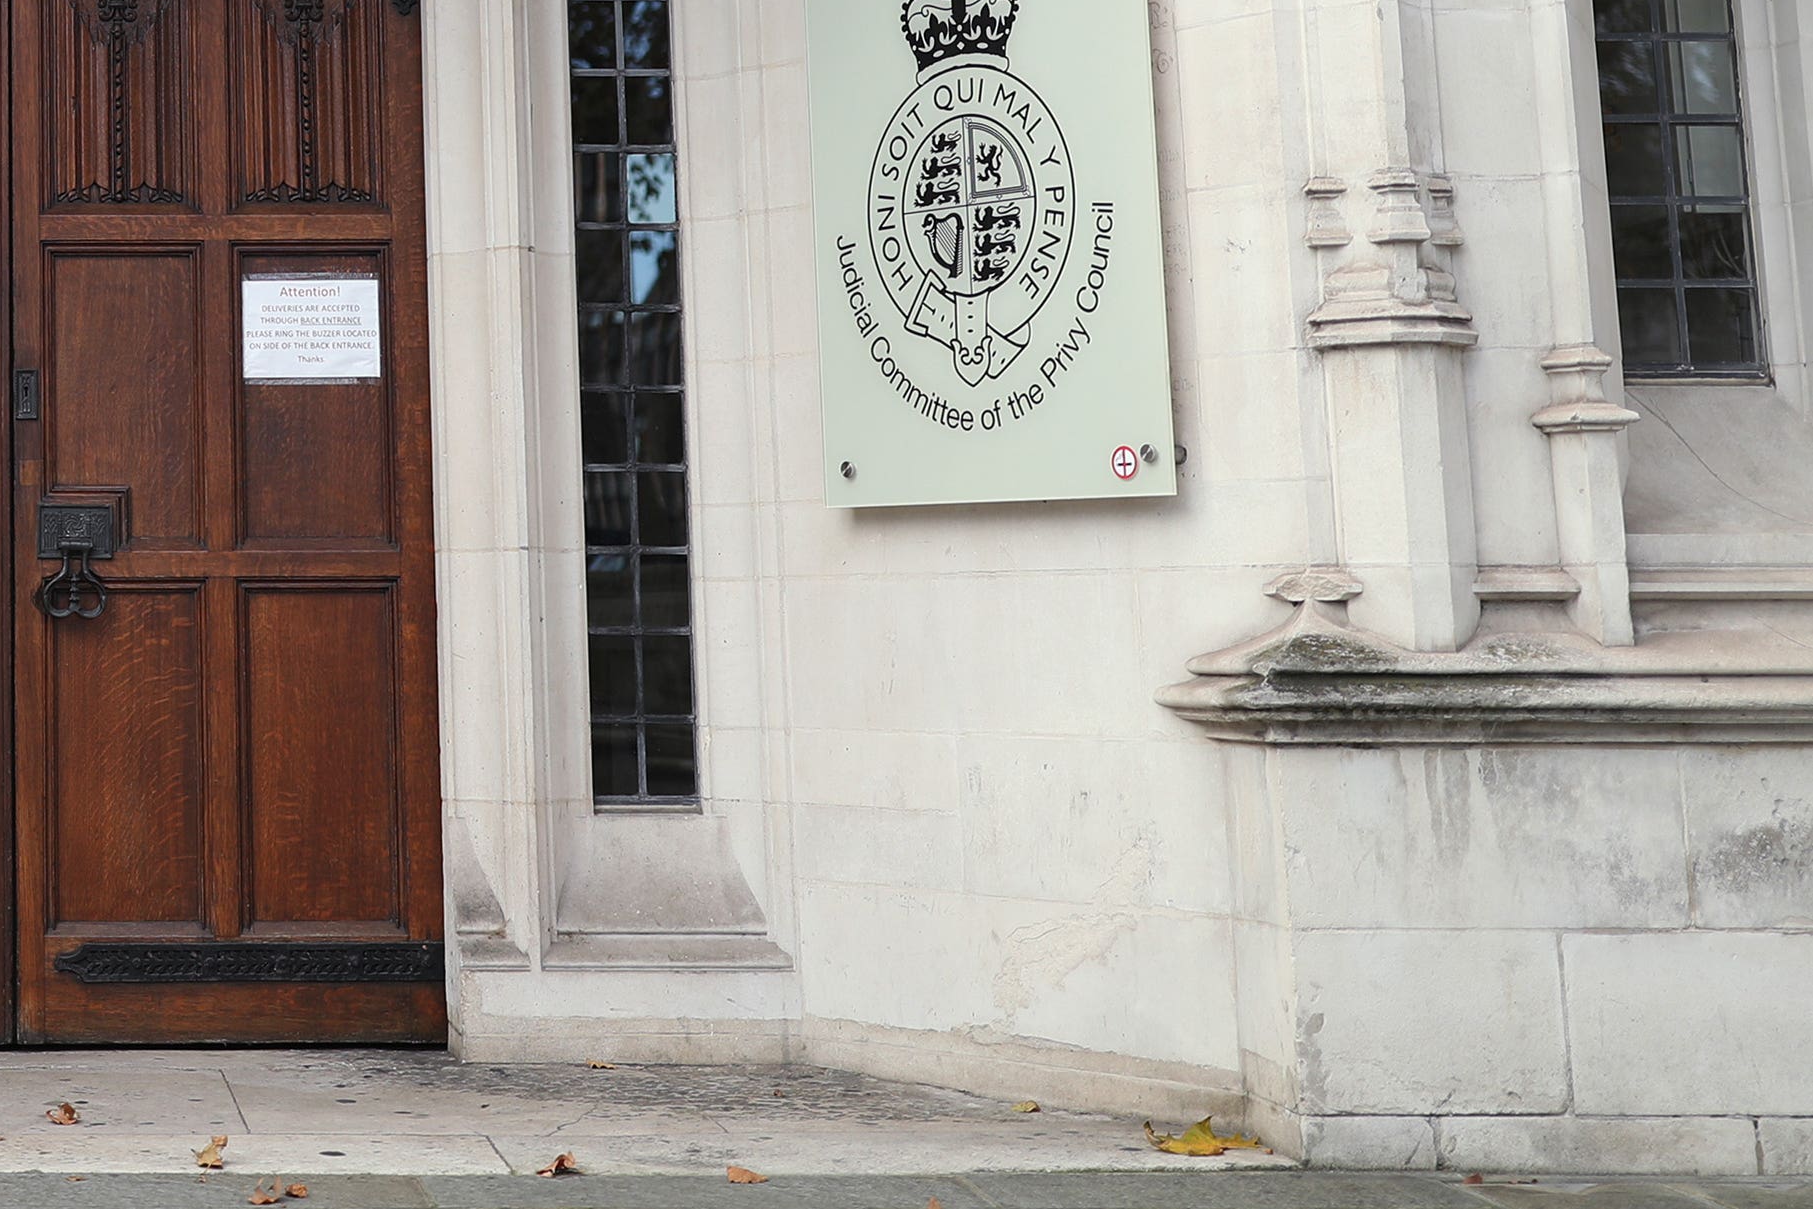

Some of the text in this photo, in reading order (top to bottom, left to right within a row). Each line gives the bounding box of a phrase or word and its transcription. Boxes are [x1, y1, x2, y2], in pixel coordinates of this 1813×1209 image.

[876, 77, 1065, 300] HONI SOIT QUI MAL Y PENSE
[279, 286, 341, 298] Attention!
[261, 304, 360, 313] DELIVERIES ARE ACCEPTED
[260, 317, 362, 325] THROUGH BACK ENTRANCE
[836, 202, 1114, 432] Judicial Committee of the Privy Council
[246, 330, 377, 338] PLEASE RING THE BUZZER LOCATED
[249, 342, 261, 350] ON
[262, 342, 279, 350] SIDE
[281, 342, 291, 350] OF
[294, 342, 308, 350] THE
[310, 342, 330, 350] BACK
[298, 355, 324, 363] Thanks
